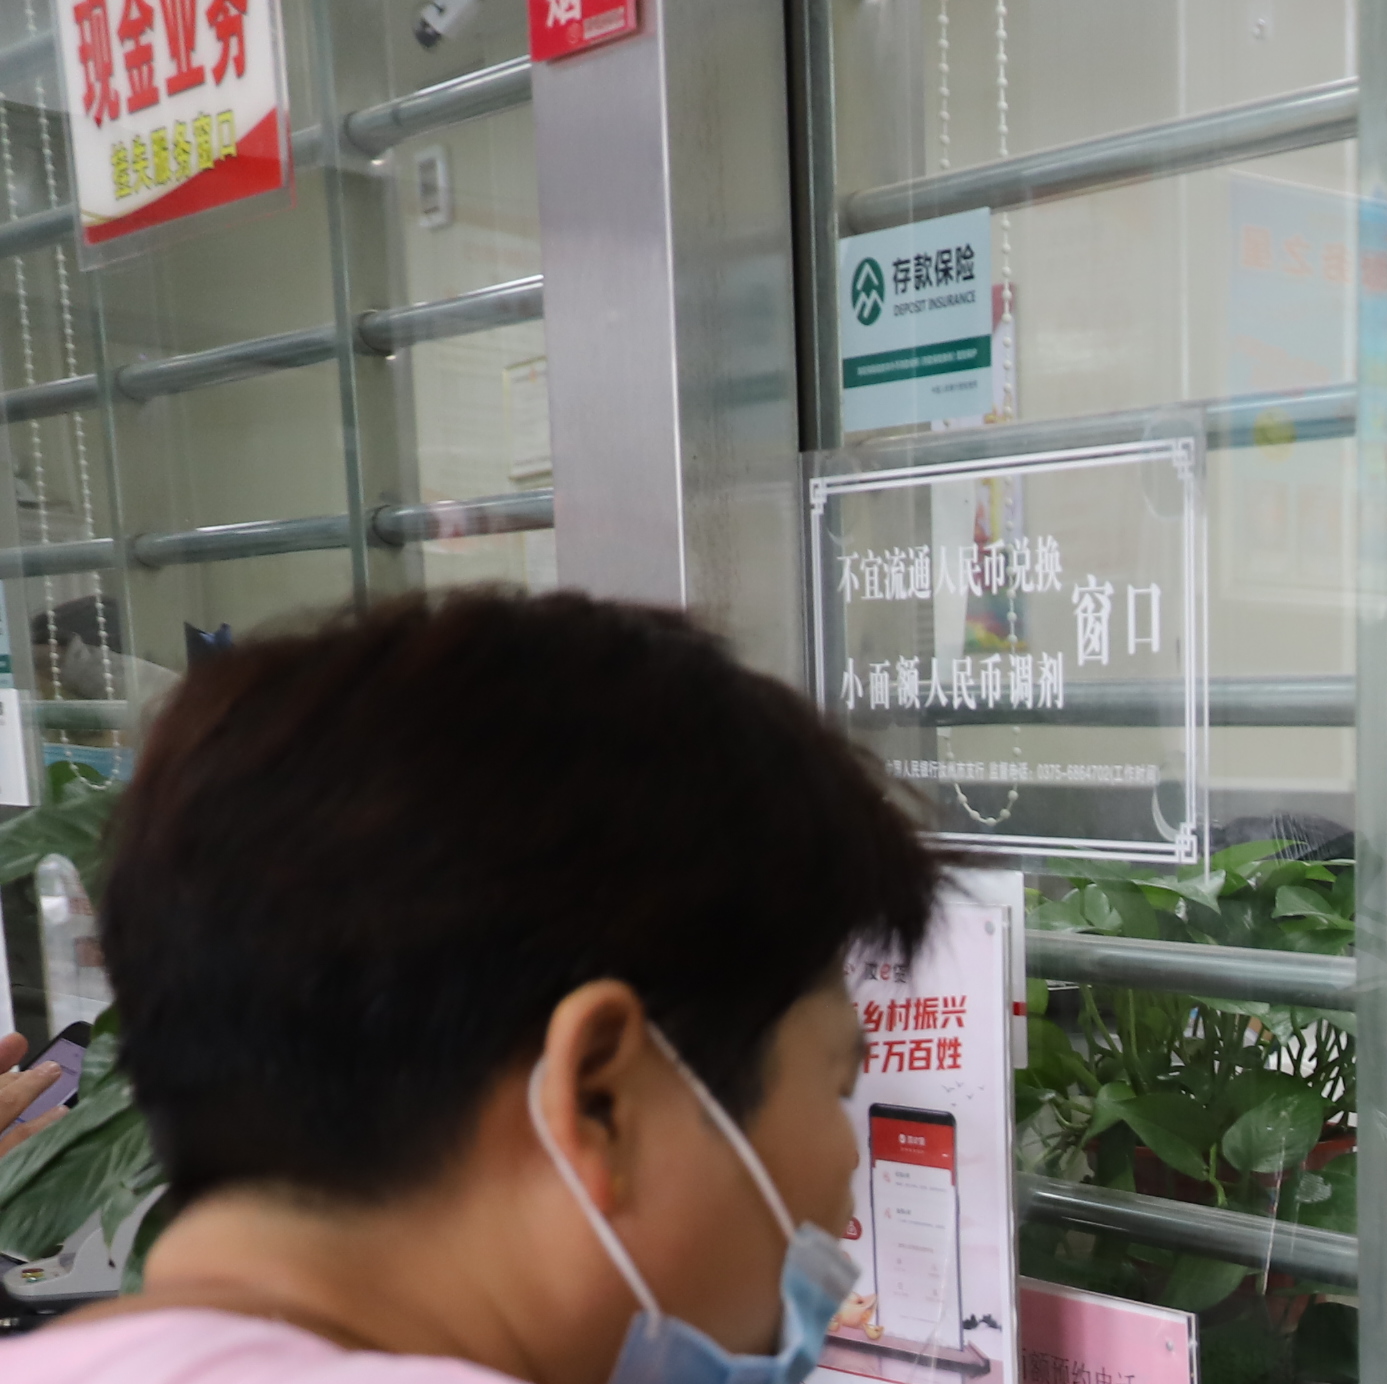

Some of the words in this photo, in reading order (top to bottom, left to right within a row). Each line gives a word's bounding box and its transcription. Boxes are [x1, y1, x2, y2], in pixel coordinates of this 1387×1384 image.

[892, 243, 976, 295] 存款保险
[893, 299, 927, 317] DEPOSIT
[928, 289, 977, 311] INSURANCE
[836, 534, 1062, 603] 不宜流通人民币兑换
[1071, 574, 1162, 667] 窗口
[841, 650, 1065, 710] 小面额人民币调剂
